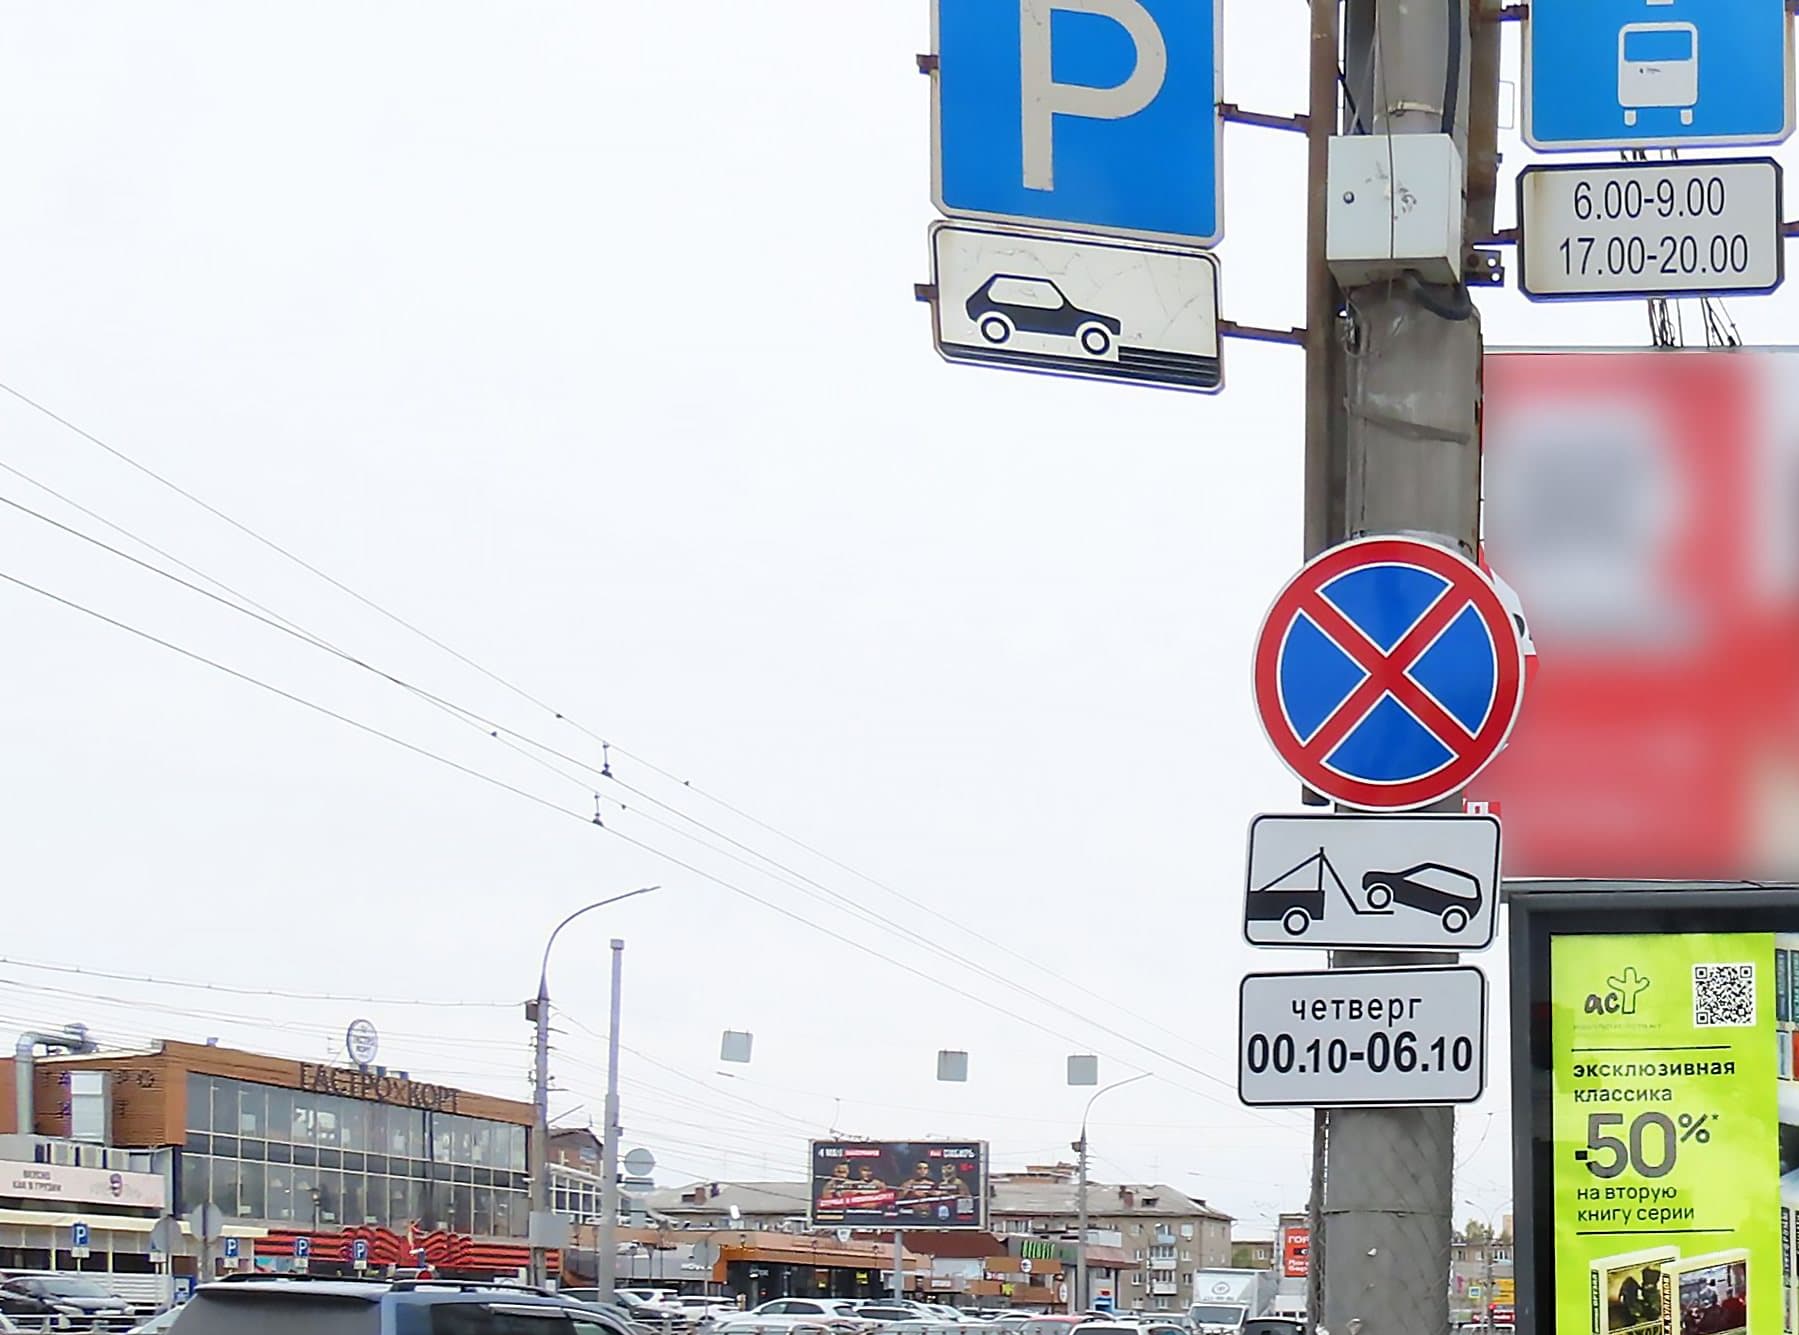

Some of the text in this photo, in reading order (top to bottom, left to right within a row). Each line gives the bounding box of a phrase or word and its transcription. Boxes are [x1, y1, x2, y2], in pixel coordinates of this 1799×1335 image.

[1018, 0, 1168, 192] P
[1571, 176, 1727, 224] 6.00-9.00
[1558, 231, 1750, 279] 17.00-20.00
[1291, 995, 1422, 1026] четверг
[1246, 1031, 1473, 1075] 00.10-06.10
[1573, 1061, 1736, 1078] эксклюзивная
[1574, 1087, 1673, 1103] классика
[1577, 1186, 1678, 1203] на вторую
[1577, 1207, 1695, 1225] книгу серии
